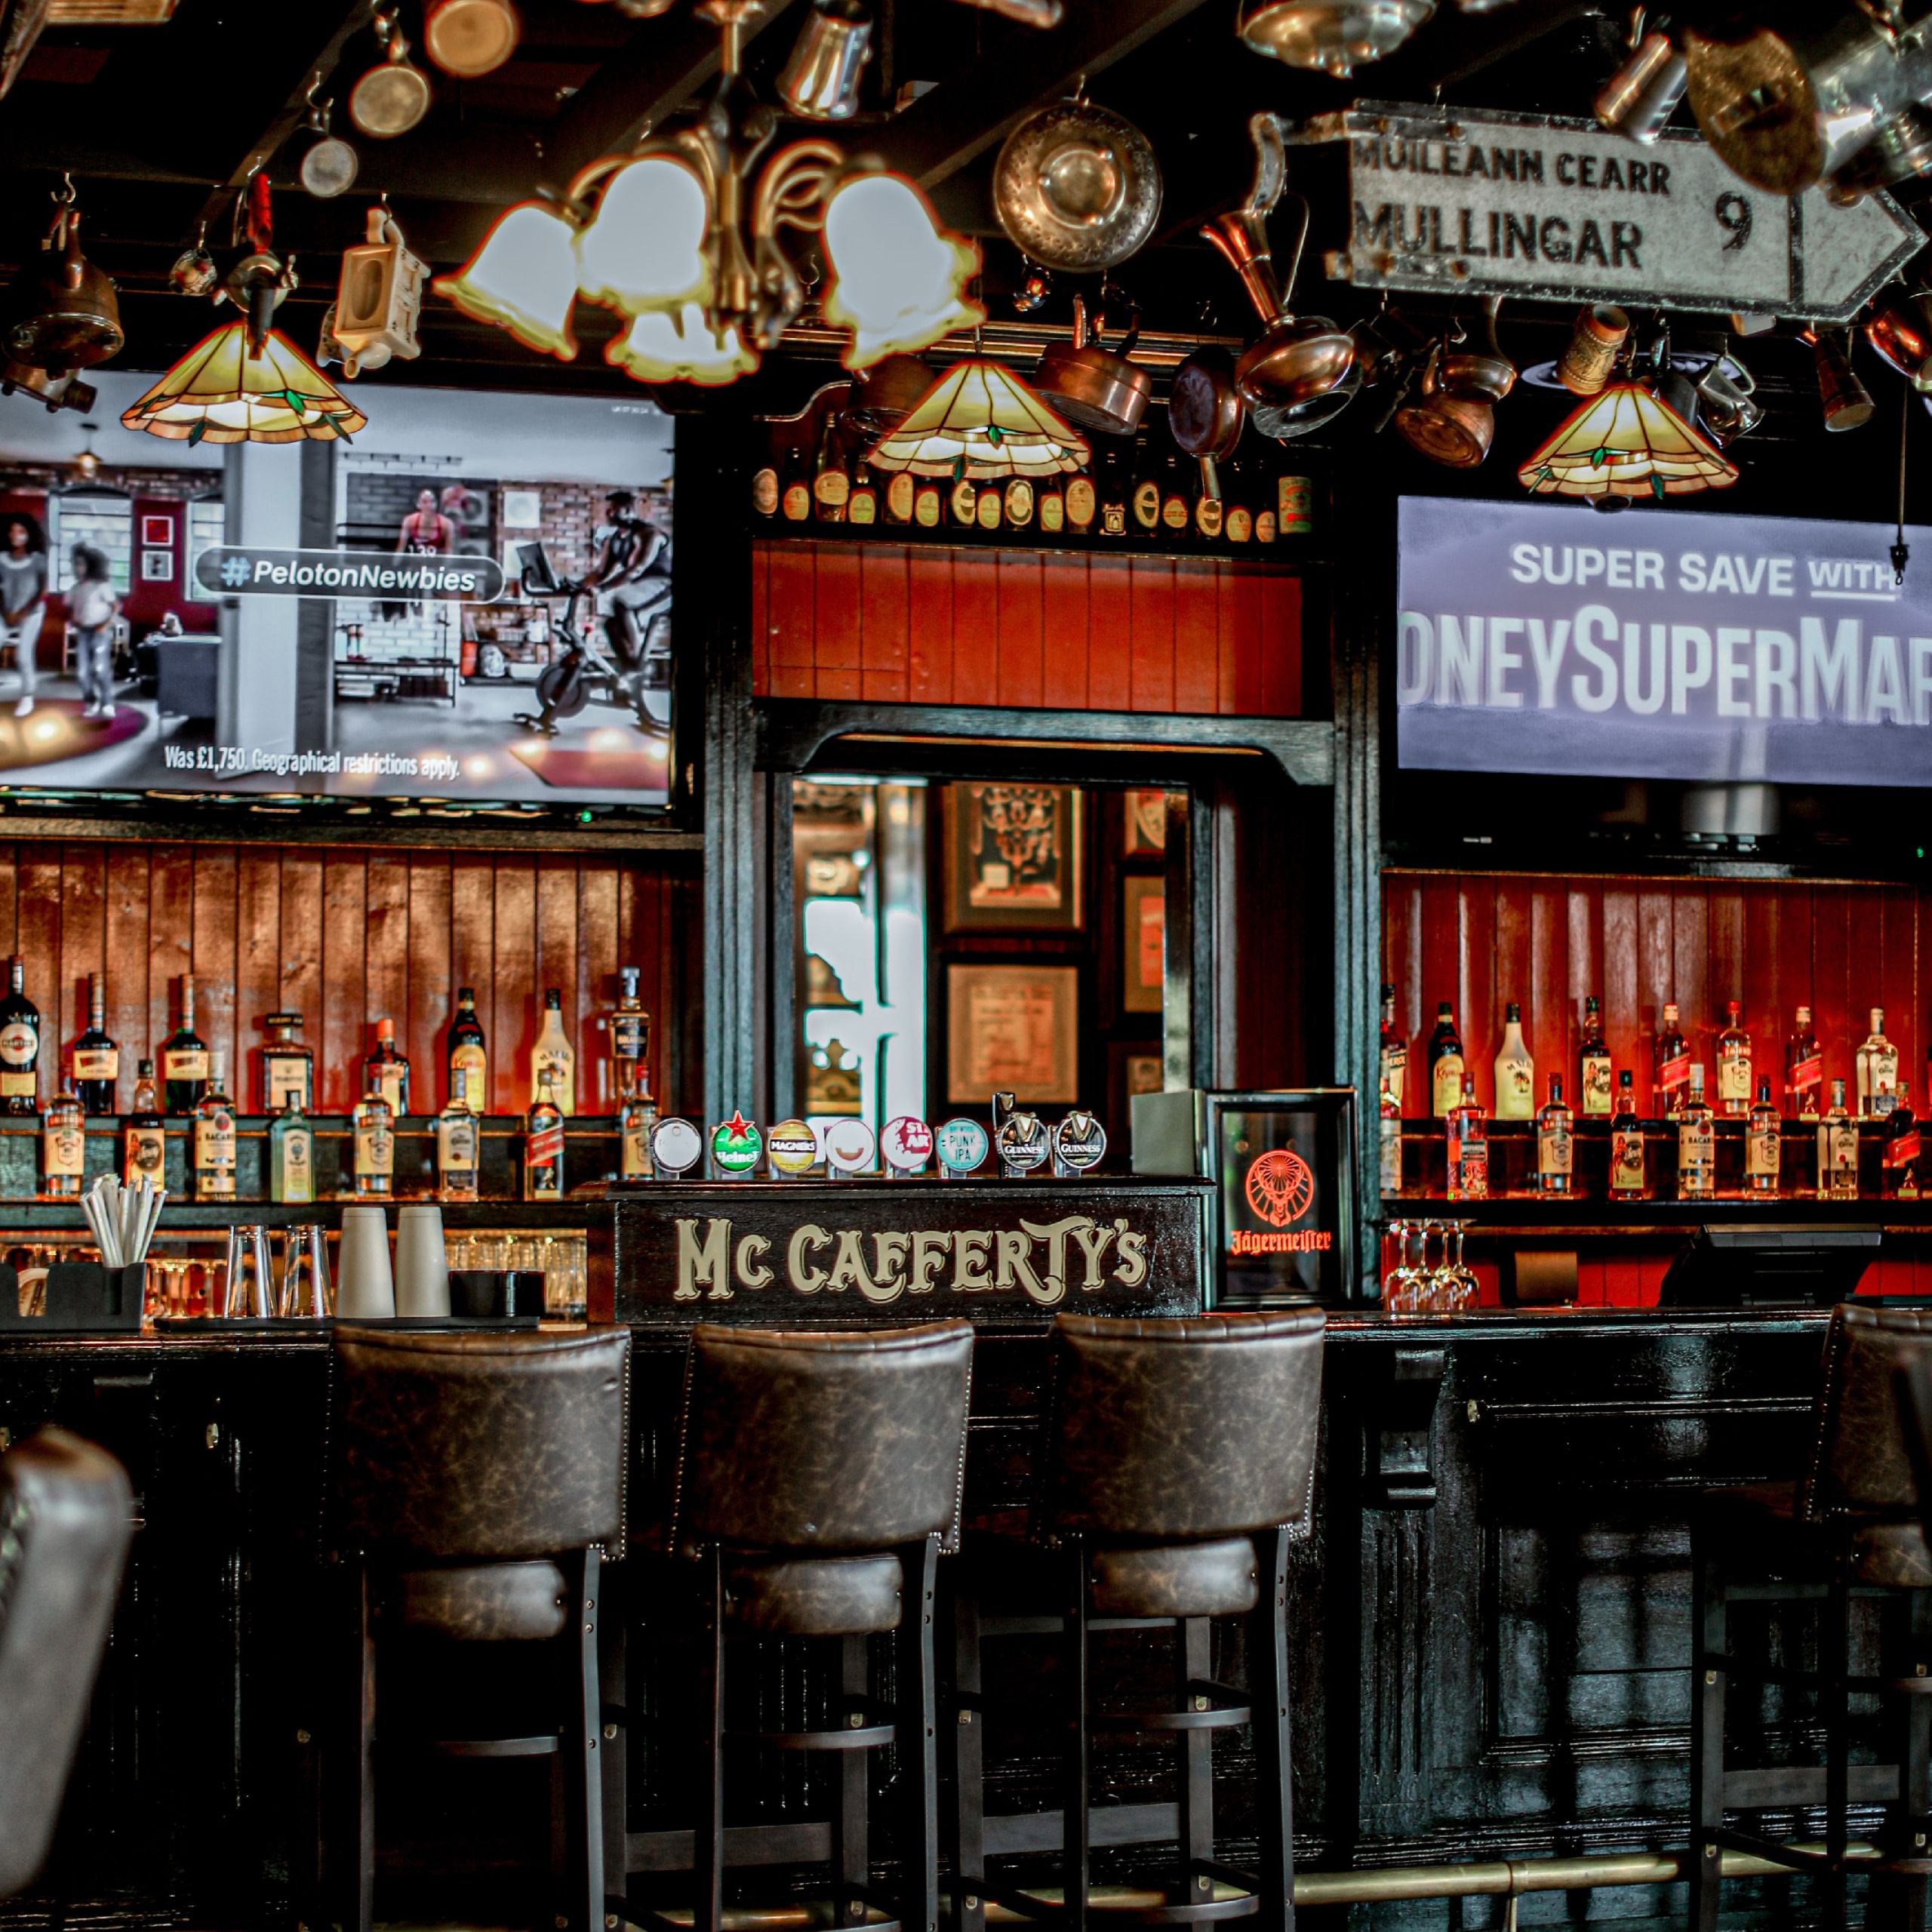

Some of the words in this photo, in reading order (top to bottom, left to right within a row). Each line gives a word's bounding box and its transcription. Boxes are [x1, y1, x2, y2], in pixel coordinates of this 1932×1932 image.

[1556, 155, 1671, 195] CEARR
[1354, 201, 1644, 270] MULLINGAR
[1715, 190, 1753, 251] 9
[221, 556, 476, 592] #PelotonNewbies
[1512, 543, 1666, 590] SUPER
[1679, 552, 1795, 597] SAVE
[1808, 560, 1897, 590] WITH
[164, 745, 194, 769] Was
[196, 746, 248, 773] £1,750.
[252, 748, 340, 777] Geographical
[343, 752, 418, 777] restrictions
[421, 755, 460, 780] apply.
[771, 1140, 815, 1152] MAGNERS
[949, 1135, 976, 1147] PUNK
[955, 1149, 971, 1161] IPA
[1004, 1145, 1045, 1155] GUINNESS
[1060, 1143, 1101, 1153] GUINNESS
[1230, 1229, 1333, 1257] Jägermeister
